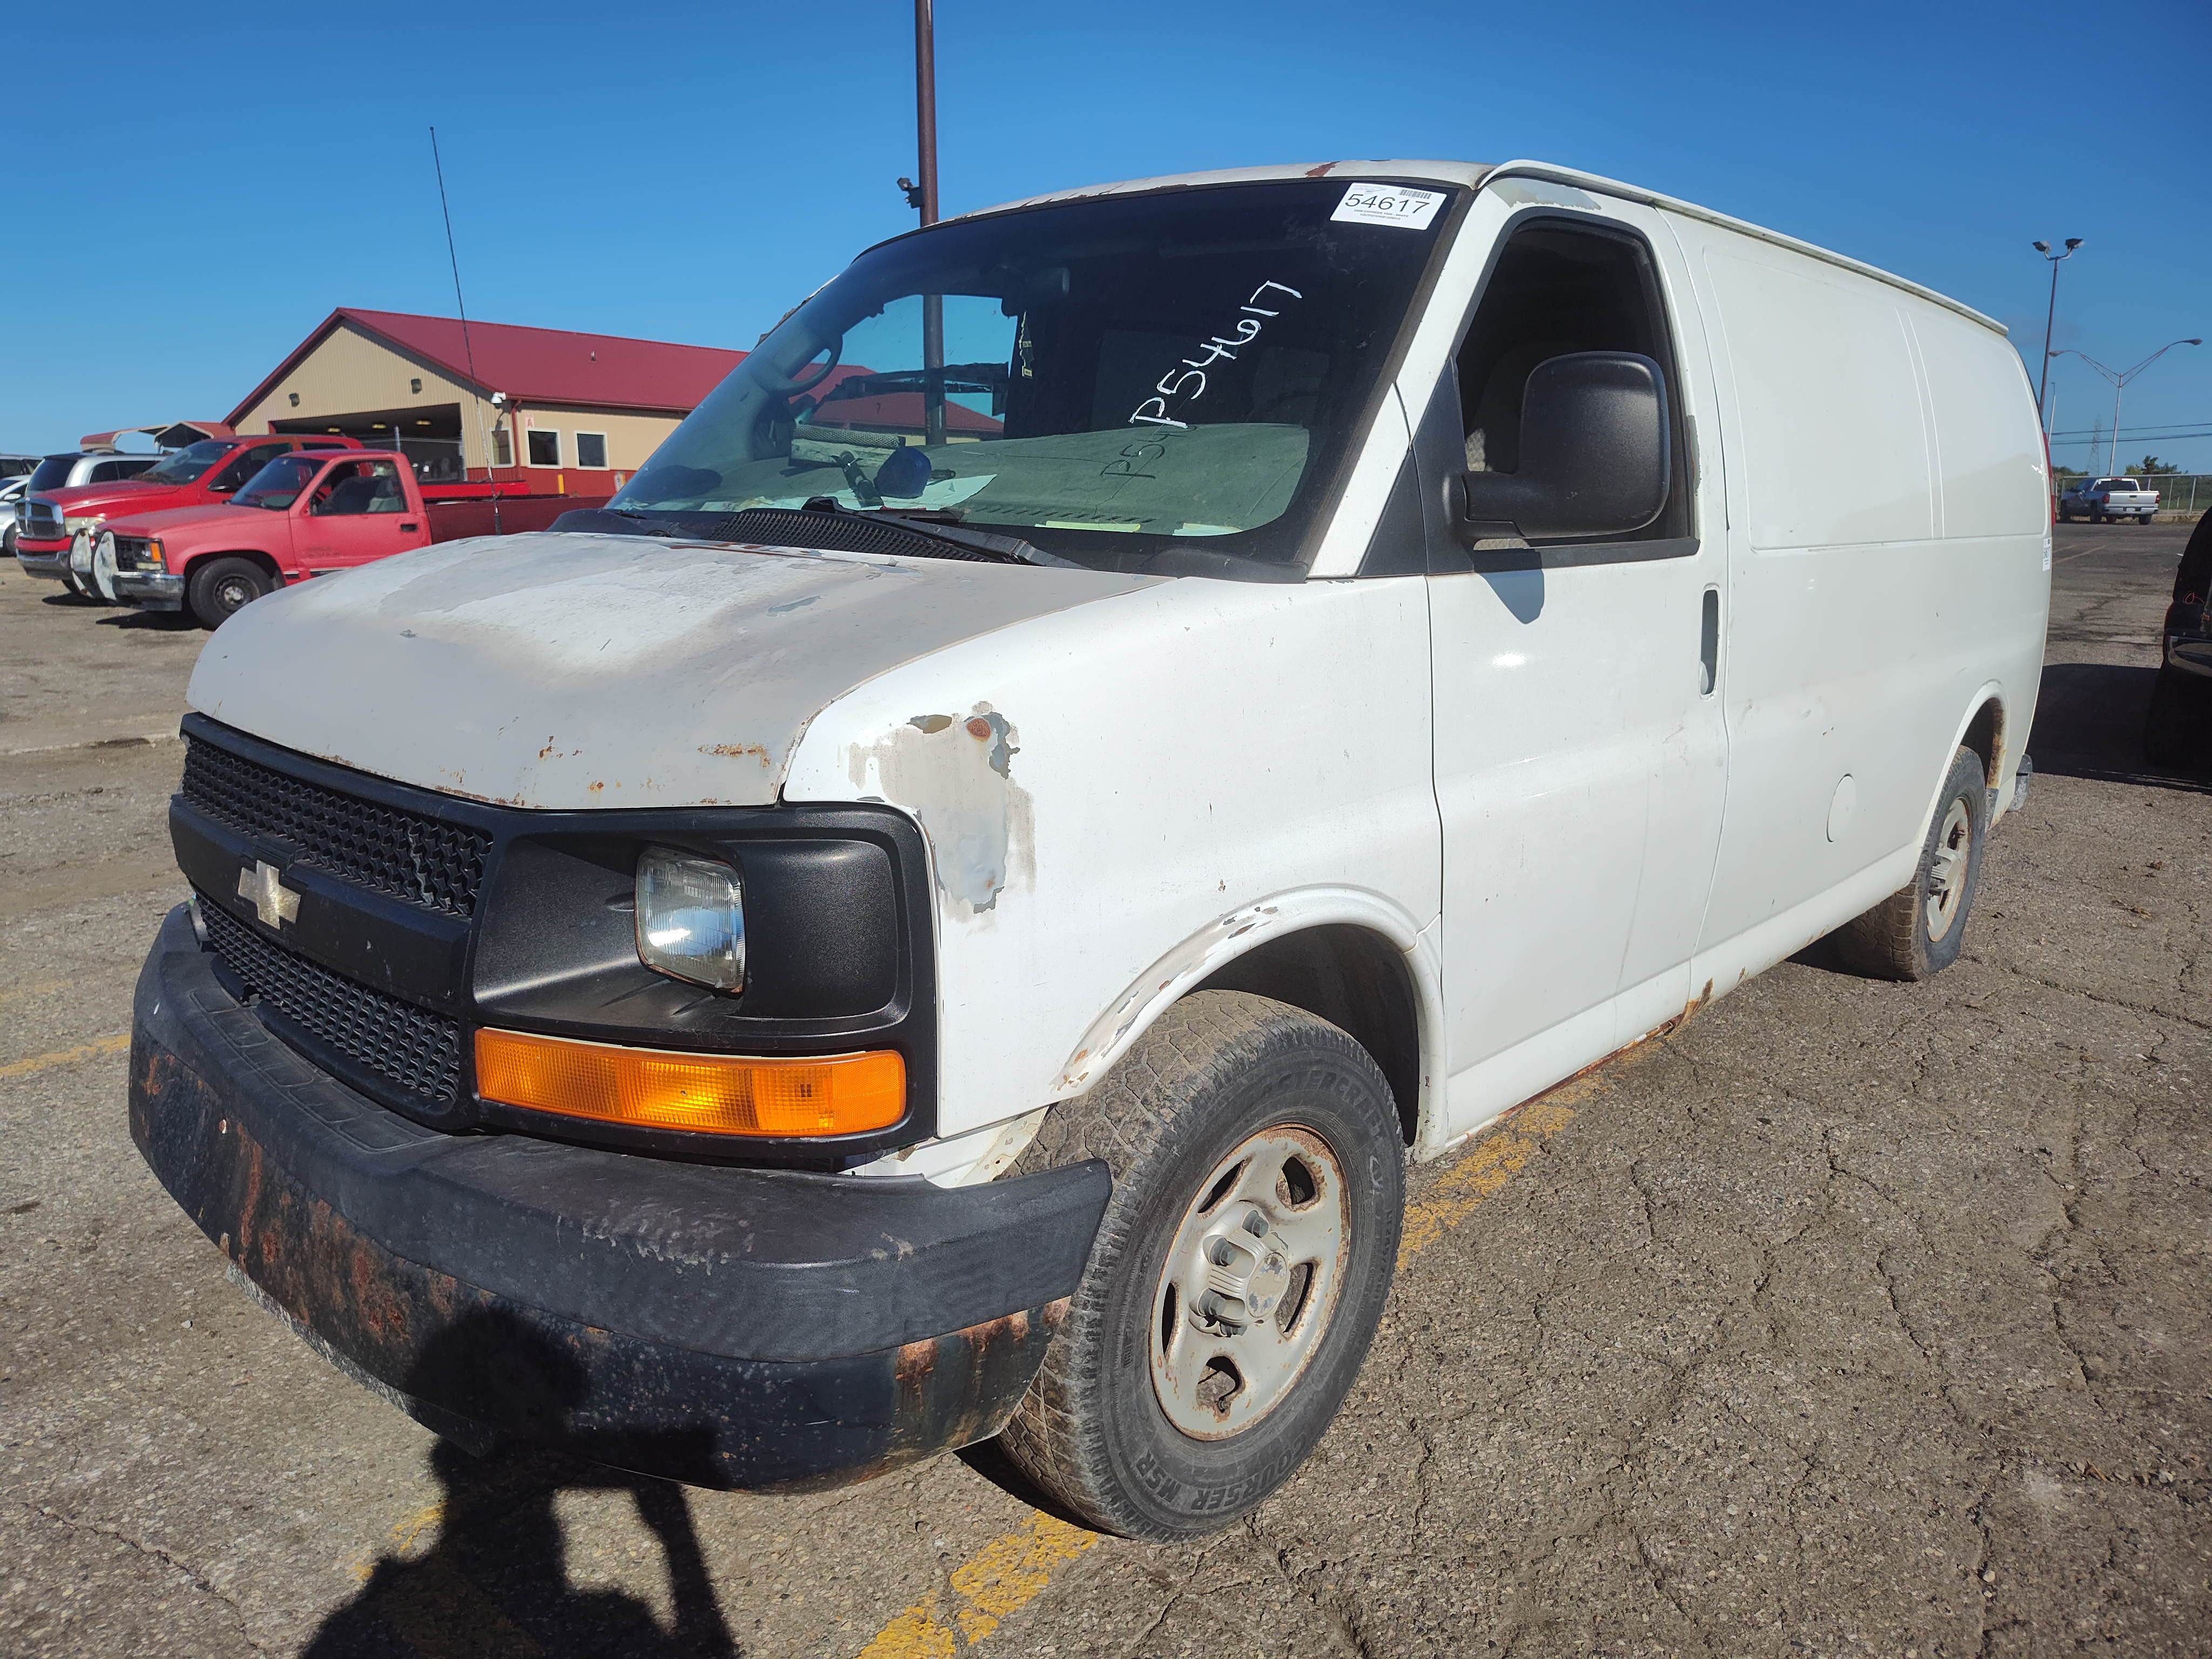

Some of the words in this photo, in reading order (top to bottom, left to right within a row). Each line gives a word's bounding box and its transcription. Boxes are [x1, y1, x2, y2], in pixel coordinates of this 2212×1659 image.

[1345, 193, 1431, 214] 54617
[1129, 280, 1303, 429] P54617
[1136, 1449, 1182, 1503] MSR
[1190, 1434, 1310, 1511] COURSER
